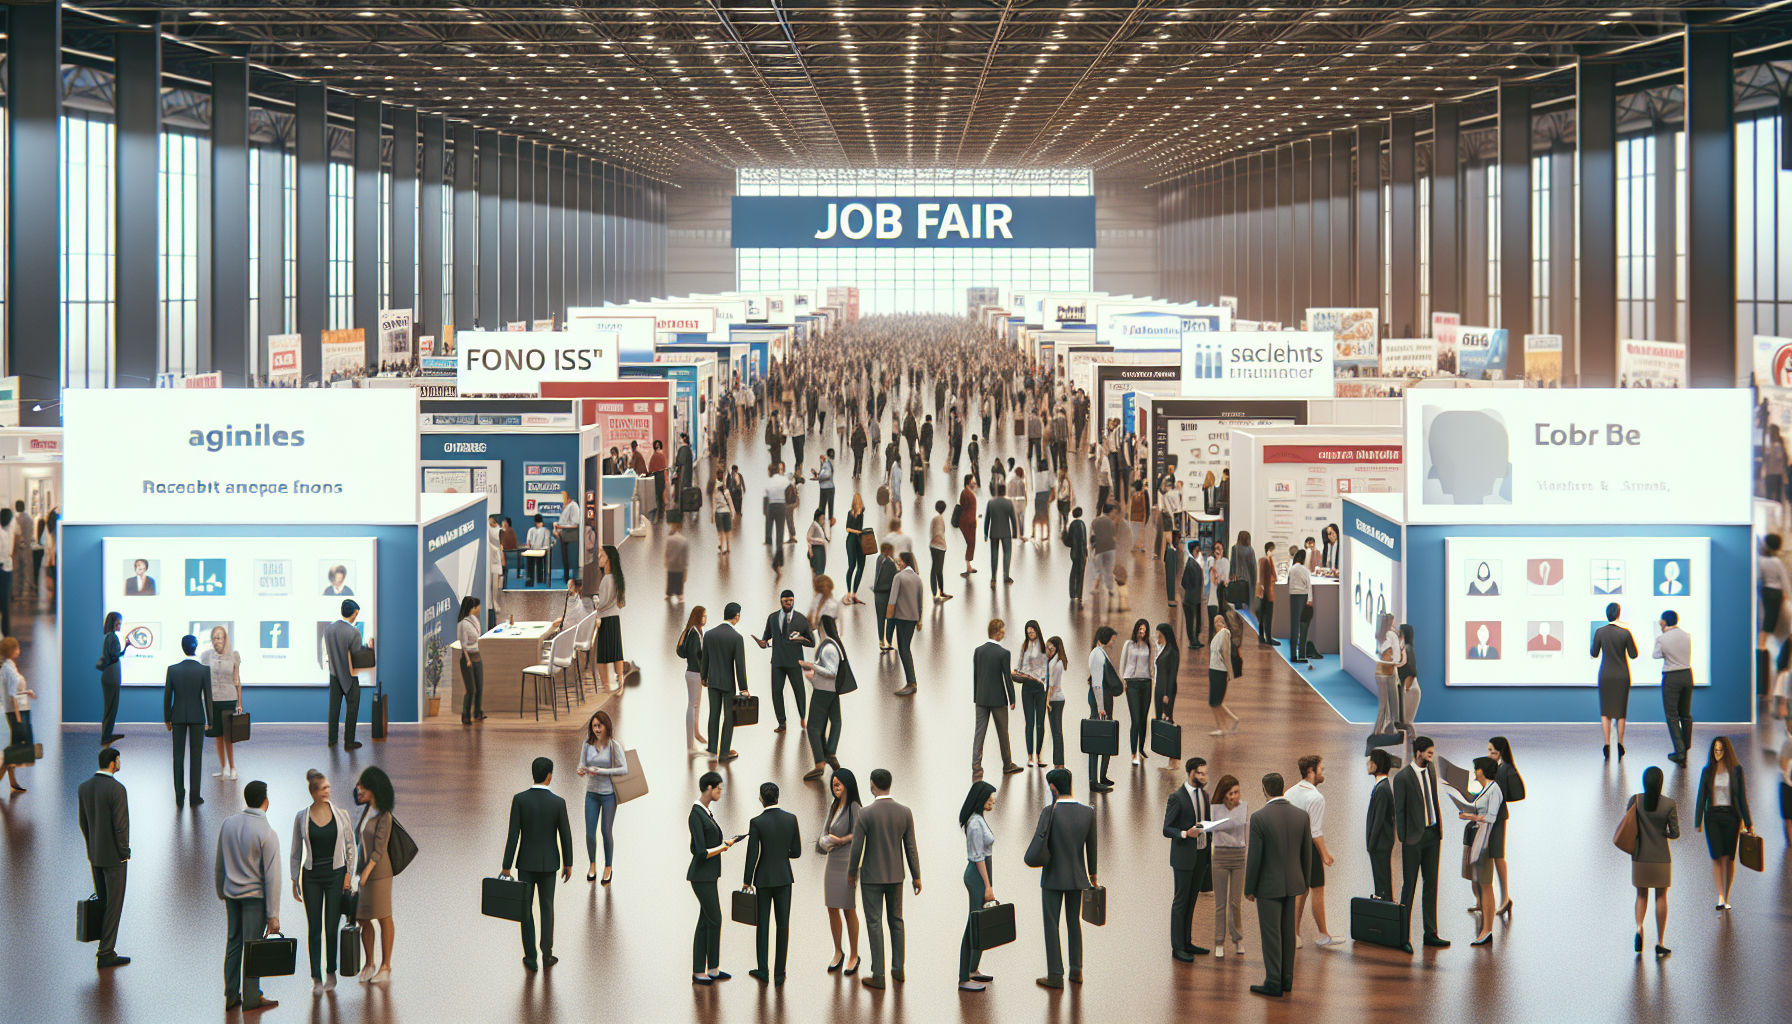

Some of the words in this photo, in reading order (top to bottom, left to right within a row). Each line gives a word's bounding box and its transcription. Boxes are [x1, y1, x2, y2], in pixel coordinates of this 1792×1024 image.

[814, 203, 902, 239] JOB
[917, 203, 1013, 239] FAIR
[467, 348, 545, 371] FONO
[188, 423, 305, 452] aginiles
[1606, 423, 1641, 446] Be
